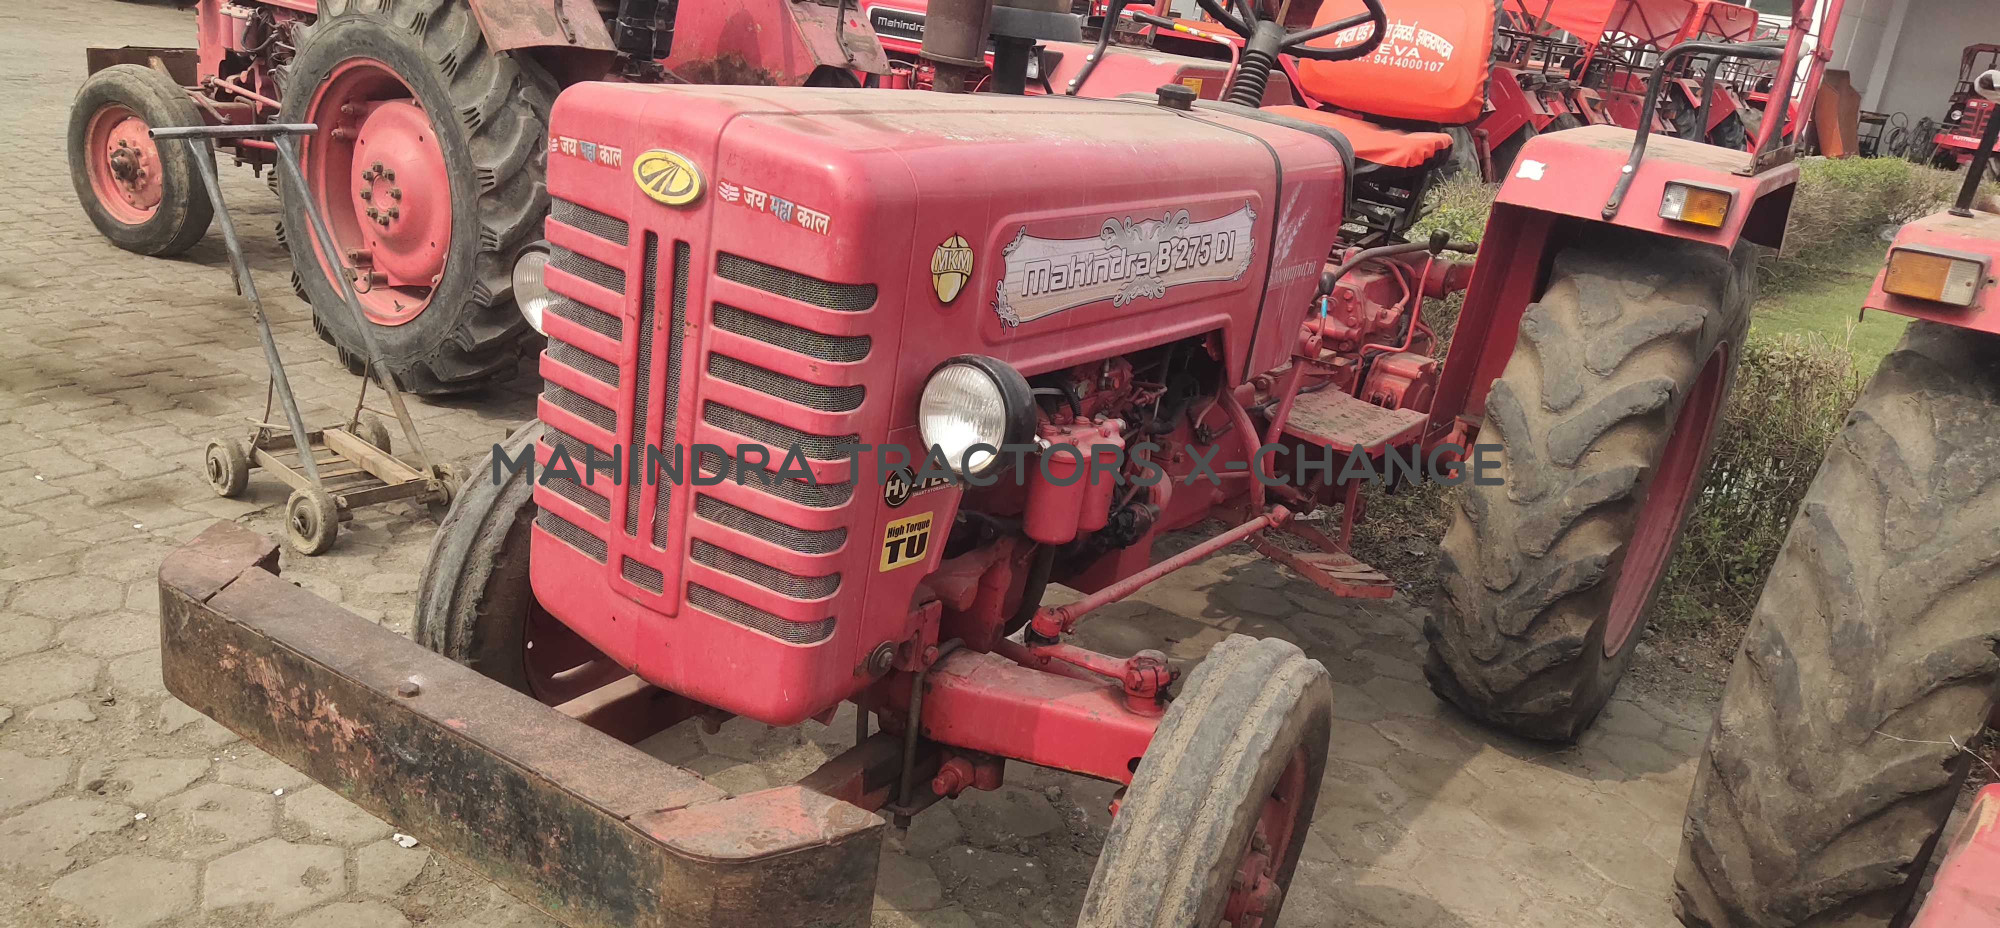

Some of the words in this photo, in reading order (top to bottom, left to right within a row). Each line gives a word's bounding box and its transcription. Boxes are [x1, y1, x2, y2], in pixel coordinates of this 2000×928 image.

[877, 16, 926, 32] Mahindra
[1373, 54, 1445, 72] 9414000107
[559, 135, 577, 157] जय
[598, 144, 622, 167] काल
[742, 185, 767, 212] जय
[769, 194, 794, 222] महा
[796, 204, 830, 235] काल
[934, 248, 971, 273] MKM
[1021, 248, 1151, 297] Mahindra
[1214, 229, 1236, 263] DI
[887, 525, 905, 538] High
[906, 519, 931, 533] Torque
[885, 532, 928, 565] TU
